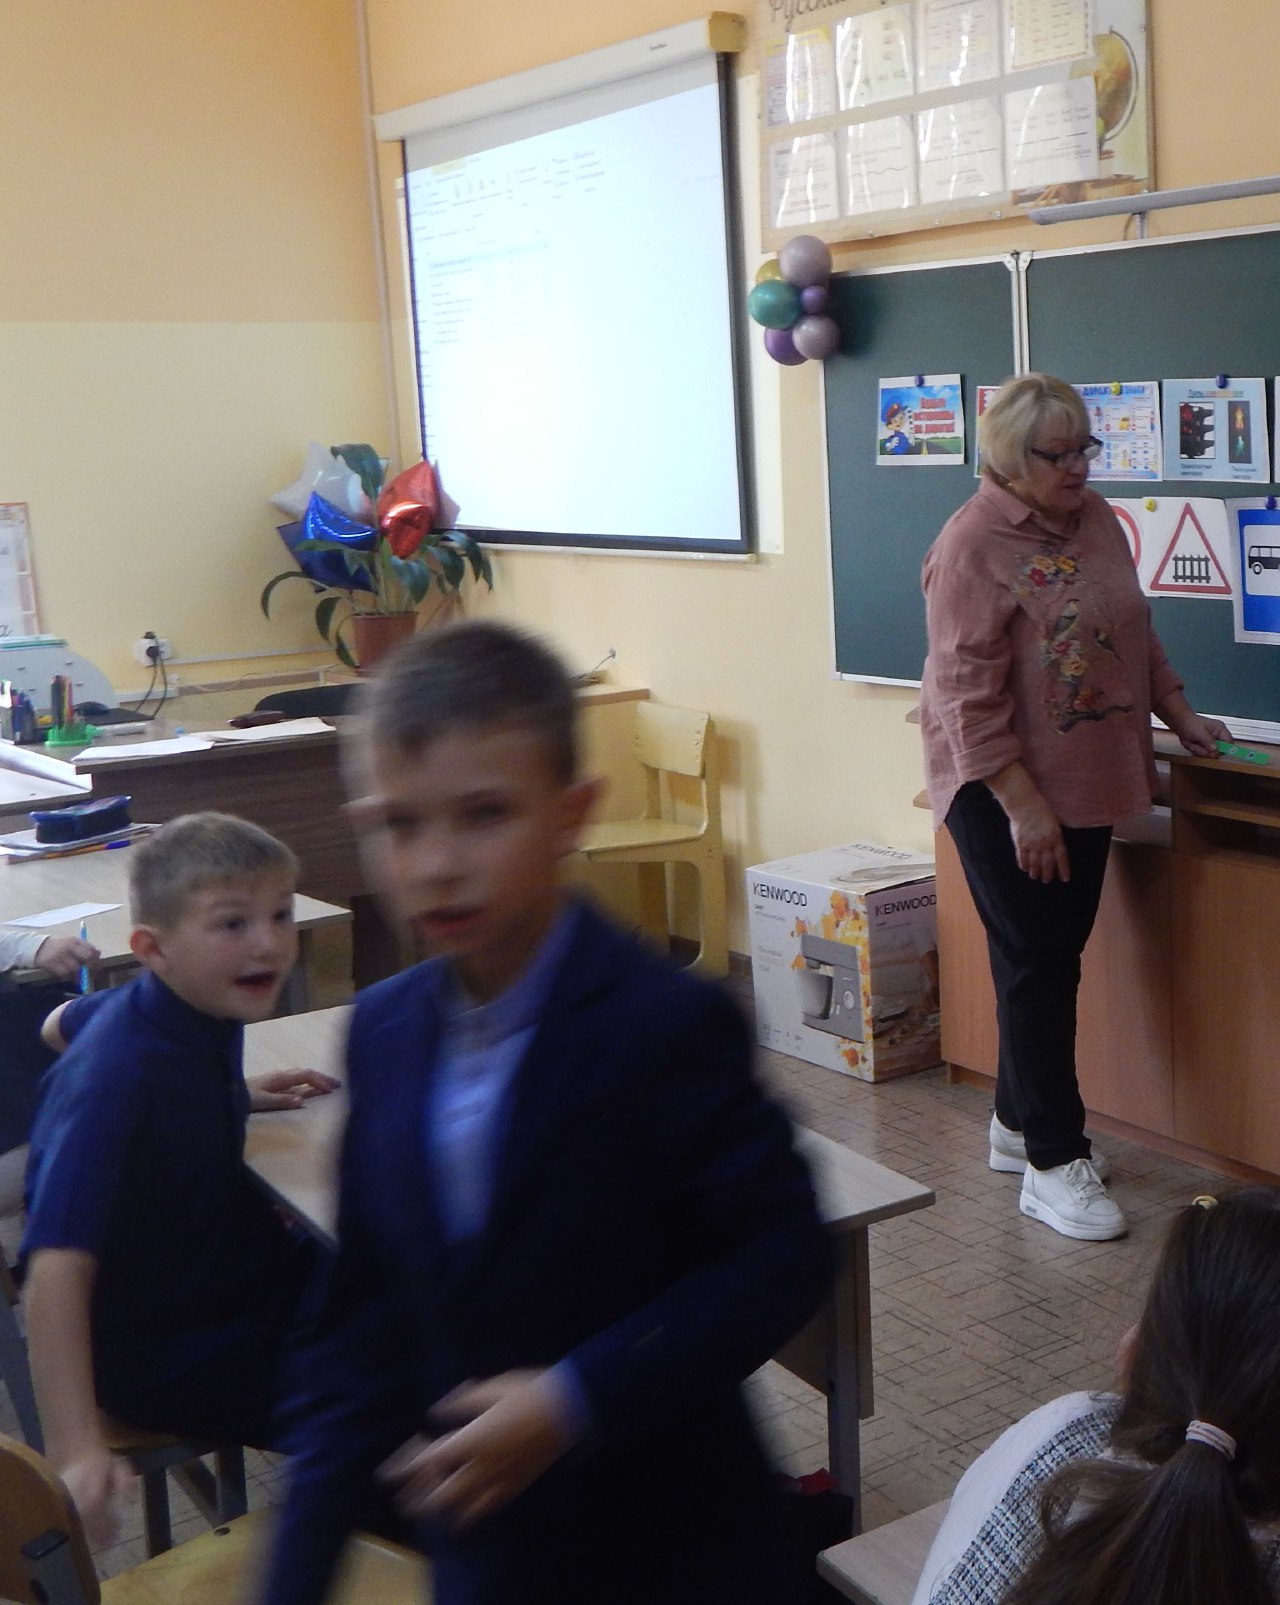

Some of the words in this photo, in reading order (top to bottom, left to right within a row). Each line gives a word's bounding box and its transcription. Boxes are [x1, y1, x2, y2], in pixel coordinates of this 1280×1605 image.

[850, 843, 912, 860] KENWOOD
[753, 882, 808, 907] KENWOOD
[875, 894, 938, 916] KENWOOD
